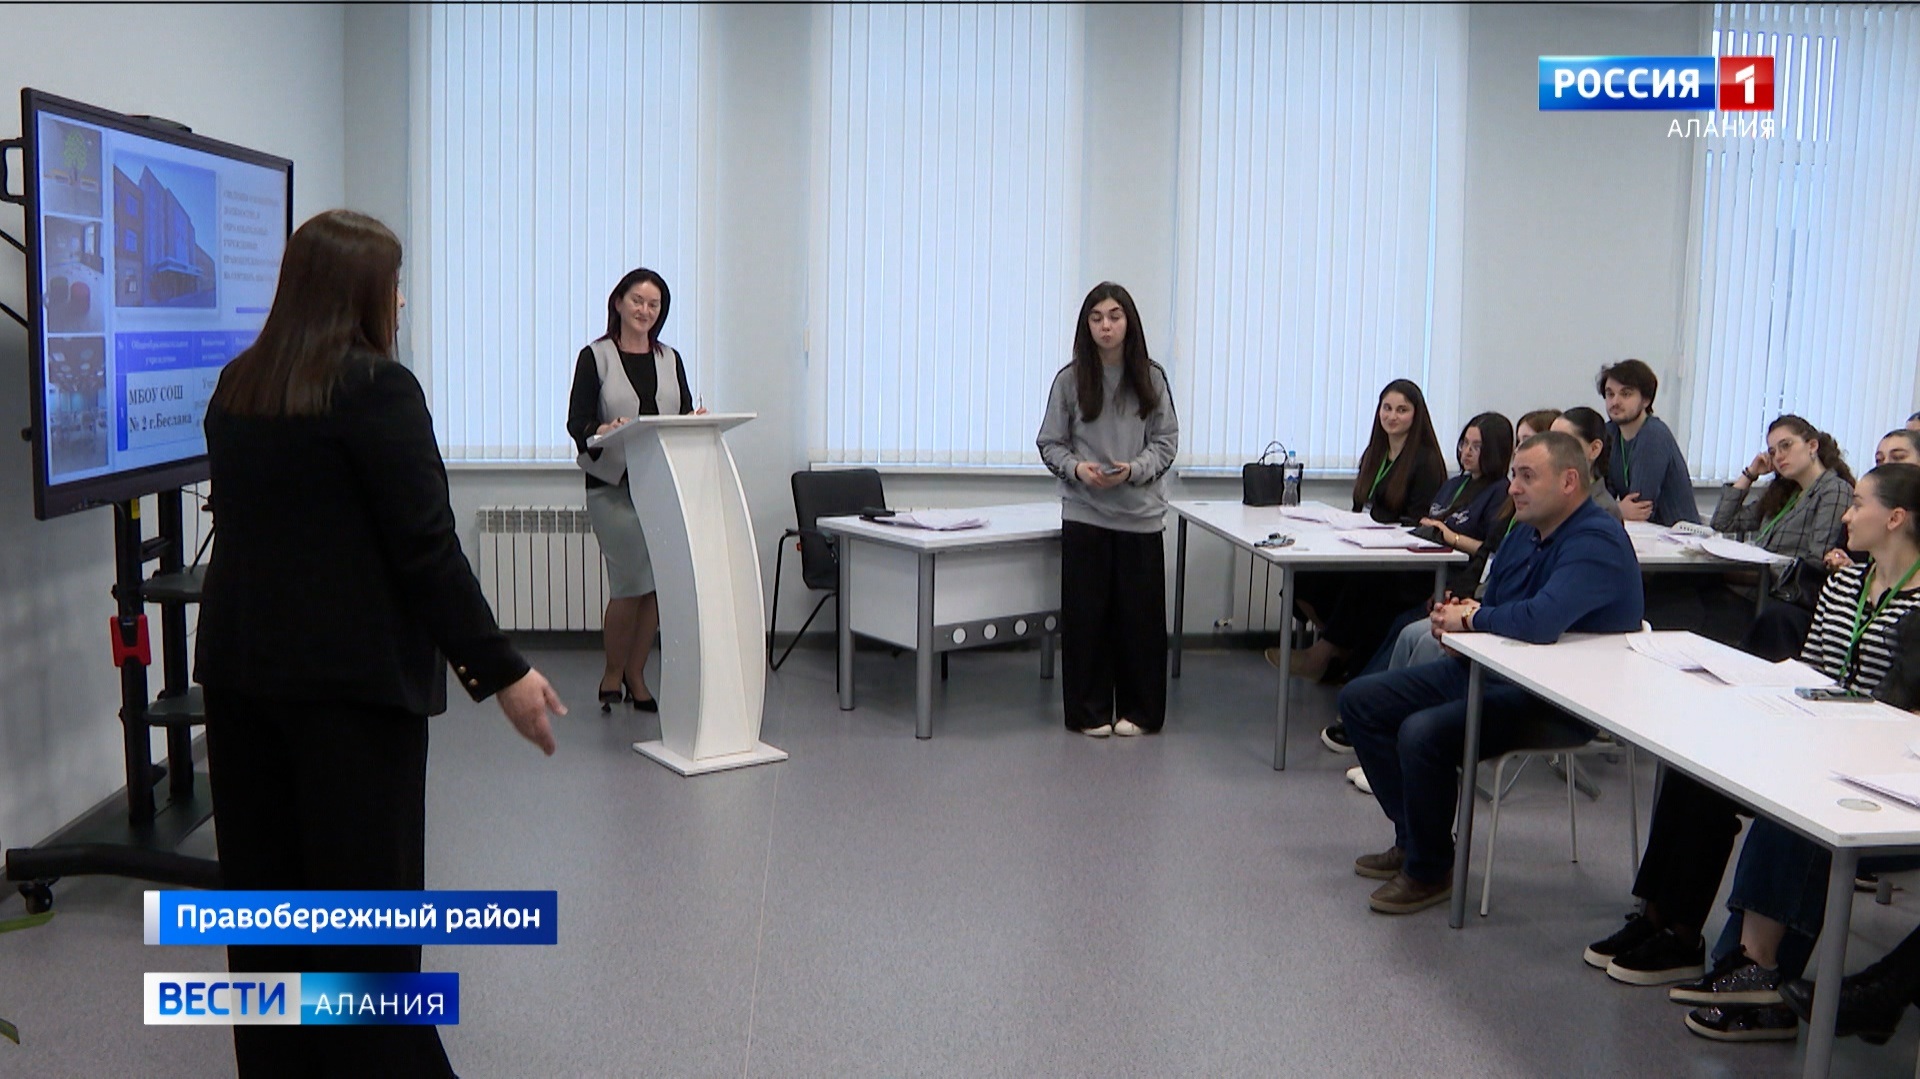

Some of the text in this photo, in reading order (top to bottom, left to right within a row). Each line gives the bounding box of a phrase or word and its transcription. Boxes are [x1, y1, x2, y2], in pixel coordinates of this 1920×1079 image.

[129, 385, 183, 405] МБОУ СОШ
[149, 413, 192, 430] г.Беслана
